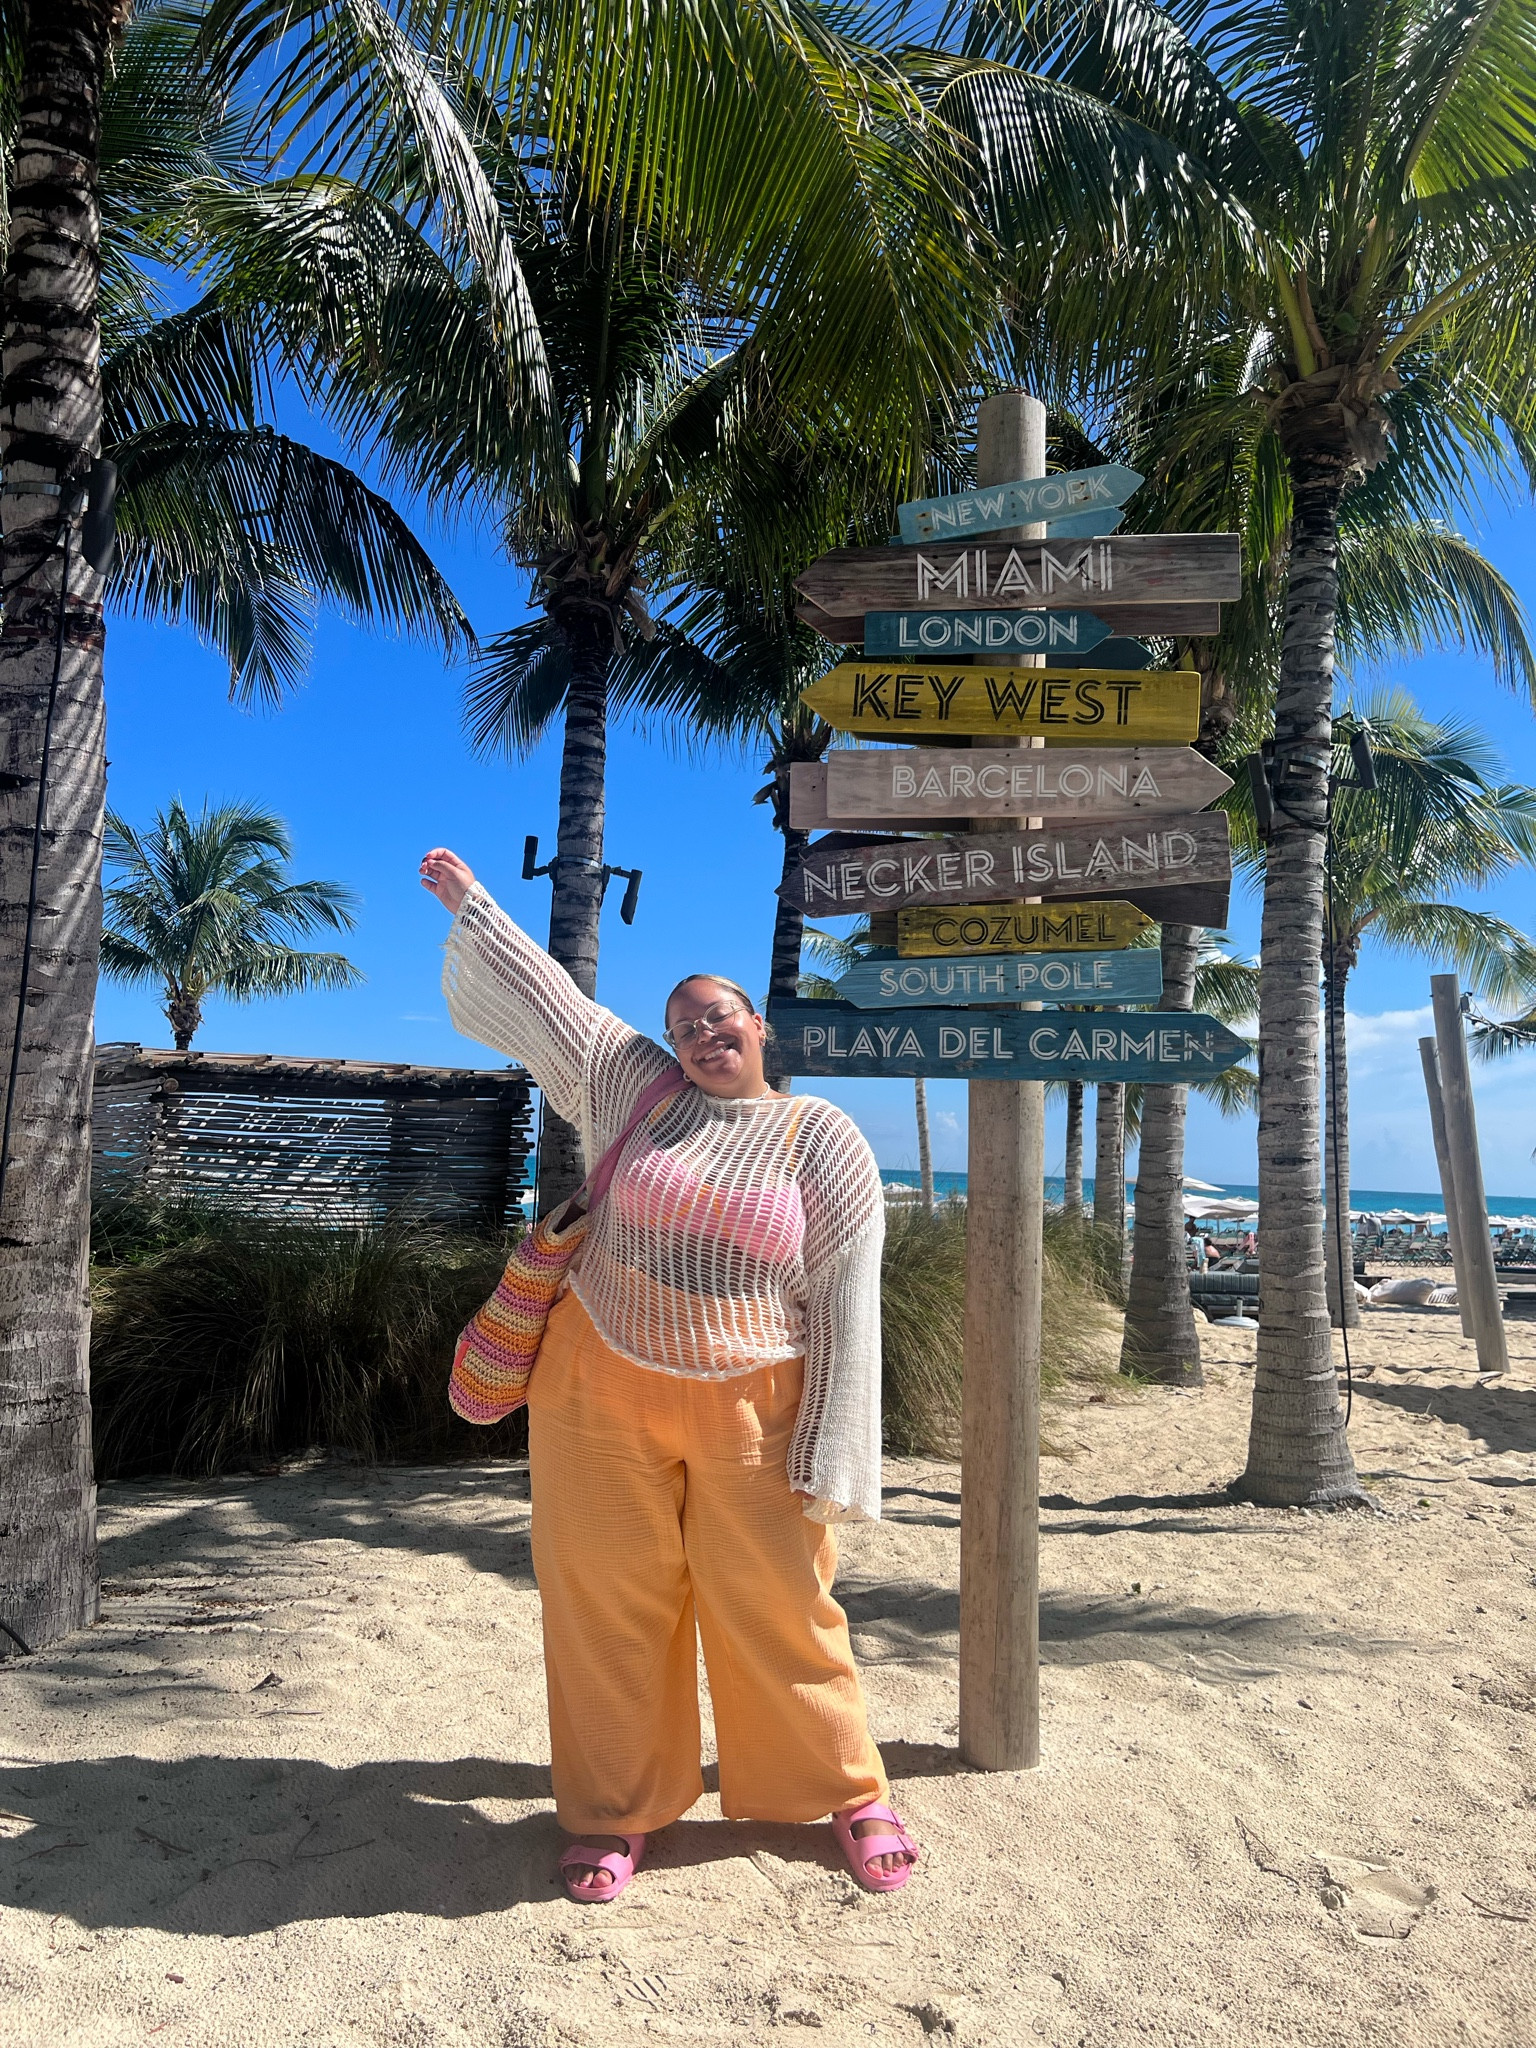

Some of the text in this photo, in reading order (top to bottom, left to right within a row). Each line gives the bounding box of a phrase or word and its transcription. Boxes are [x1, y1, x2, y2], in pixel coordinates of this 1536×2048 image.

[930, 473, 1113, 530] NEW YORK
[917, 544, 1112, 600] MIAMI
[899, 616, 1077, 648] LONDON
[853, 673, 1142, 726] KEY WEST
[892, 765, 1162, 798] BARCELONA
[803, 831, 1198, 903] NECKER ISLAND
[932, 913, 1117, 946] COZUMEL
[879, 960, 1113, 996] SOUTH POLE
[803, 1026, 1214, 1063] PLAYA DEL CARMEN
